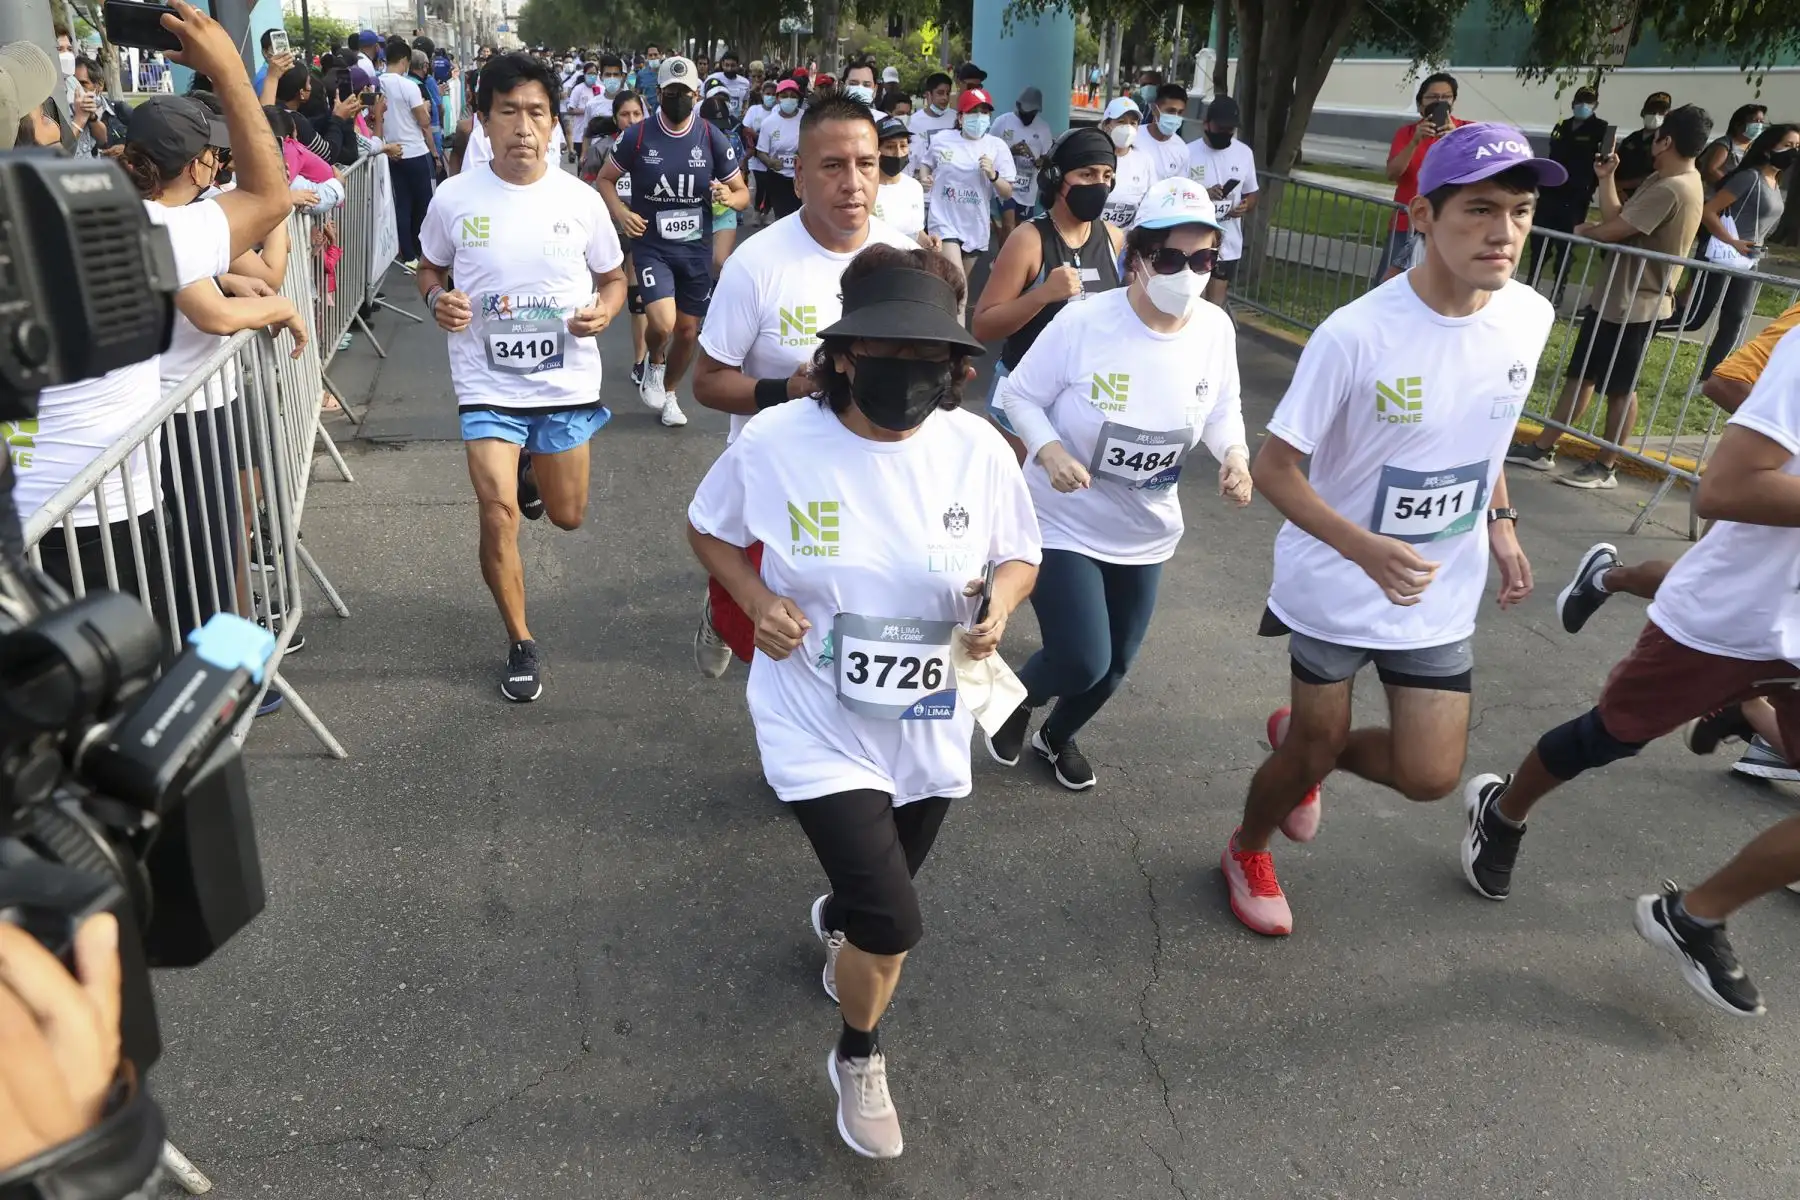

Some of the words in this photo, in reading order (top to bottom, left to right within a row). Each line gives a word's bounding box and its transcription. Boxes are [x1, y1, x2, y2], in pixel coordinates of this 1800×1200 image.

[1475, 140, 1534, 160] AVON
[617, 180, 630, 190] 59
[1102, 211, 1132, 222] 3457
[665, 219, 695, 232] 4985
[641, 266, 656, 288] 6
[516, 295, 559, 308] LIMA
[779, 337, 817, 347] I-ONE
[495, 339, 554, 359] 3410
[1090, 401, 1127, 412] I-ONE
[1377, 413, 1423, 425] I-ONE
[1107, 447, 1177, 472] 3484
[1394, 490, 1464, 520] 5411
[791, 545, 840, 557] I-ONE
[900, 626, 920, 634] LIMA
[846, 651, 943, 690] 3726
[927, 708, 951, 716] LIMA
